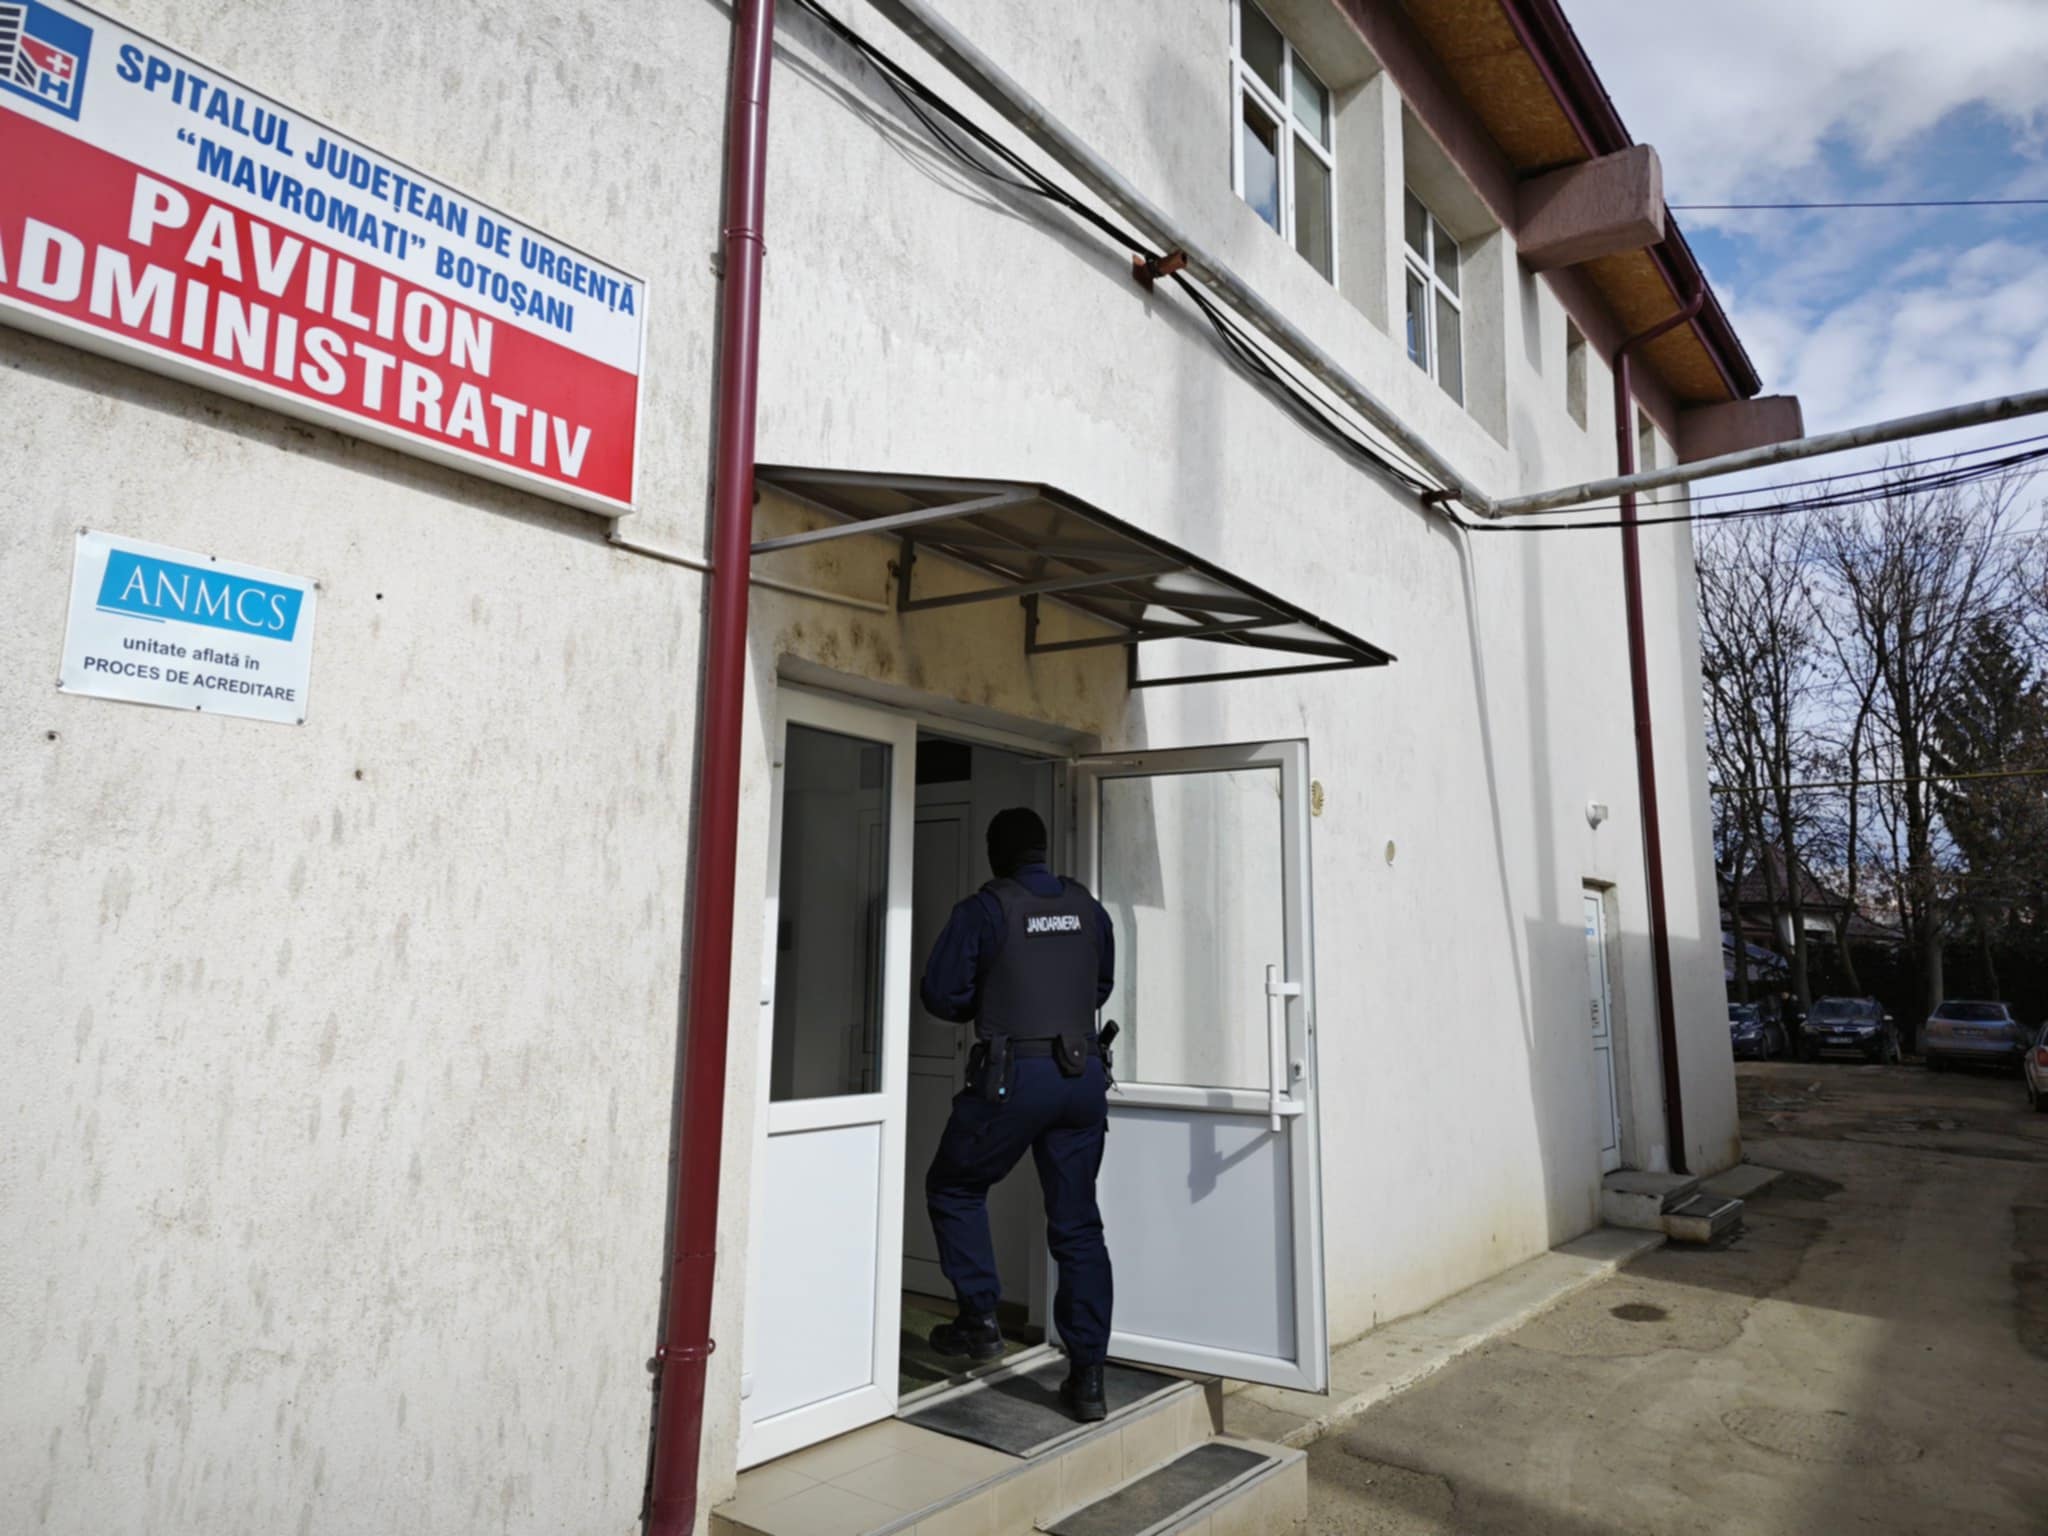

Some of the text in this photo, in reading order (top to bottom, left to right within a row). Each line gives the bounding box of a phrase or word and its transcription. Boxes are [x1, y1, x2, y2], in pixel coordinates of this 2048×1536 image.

[116, 44, 635, 316] SPITALUL JUDEȚEAN DE URGENȚĂ
[128, 172, 494, 378] PAVILION
[435, 246, 575, 333] BOTOȘANI
[0, 217, 592, 478] DMINISTRATIV
[120, 564, 287, 631] ANMCS
[83, 655, 296, 702] PROCES DE ACREDITARE
[123, 636, 260, 671] unitate aflată în
